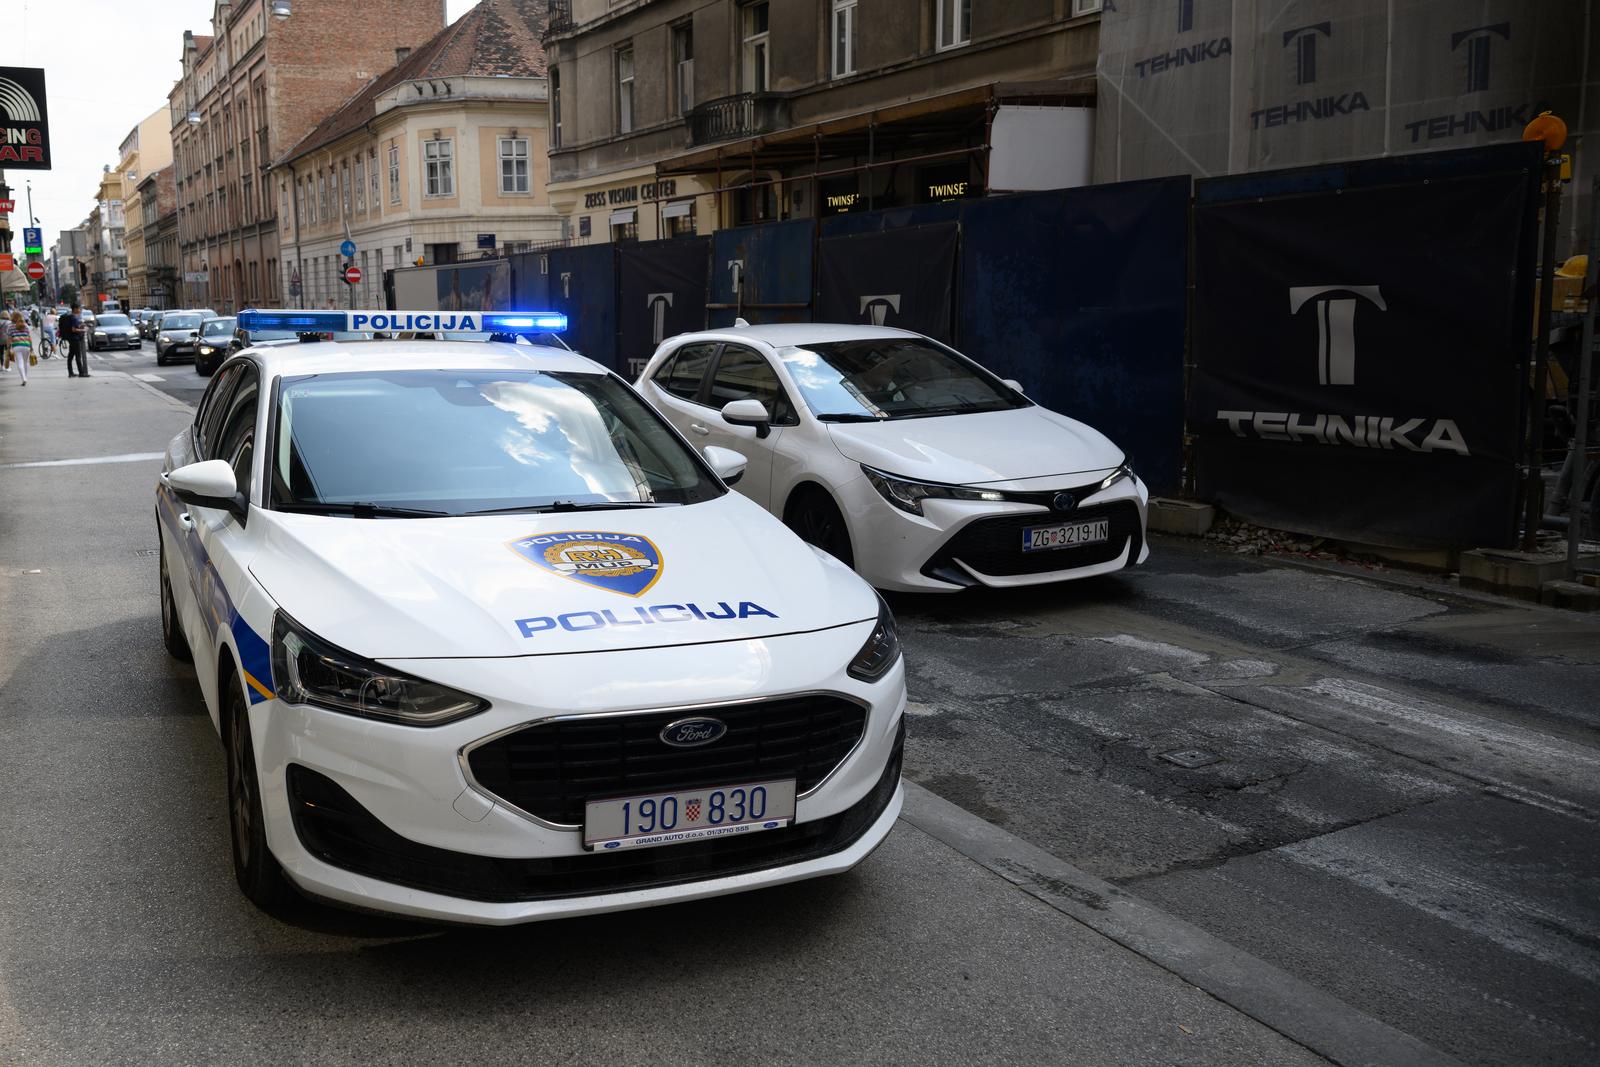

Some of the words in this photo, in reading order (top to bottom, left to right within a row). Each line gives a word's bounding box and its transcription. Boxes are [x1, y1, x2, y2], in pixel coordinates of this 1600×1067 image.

[1135, 37, 1232, 80] TEHNIKA
[1250, 91, 1370, 130] TEHNIKA
[585, 191, 606, 208] ZEISS
[608, 185, 638, 205] VISION
[641, 180, 677, 200] CENTER
[353, 314, 476, 330] POLICIJA
[1216, 410, 1471, 456] TEHNIKA
[517, 533, 642, 549] POLICIJA
[1033, 530, 1050, 547] ZG
[575, 560, 634, 570] MUP
[514, 601, 780, 639] POLICIJA
[676, 723, 713, 741] Ford
[622, 796, 678, 835] 190
[708, 786, 767, 824] 830
[635, 836, 662, 845] GRAND
[663, 833, 684, 842] AUTO
